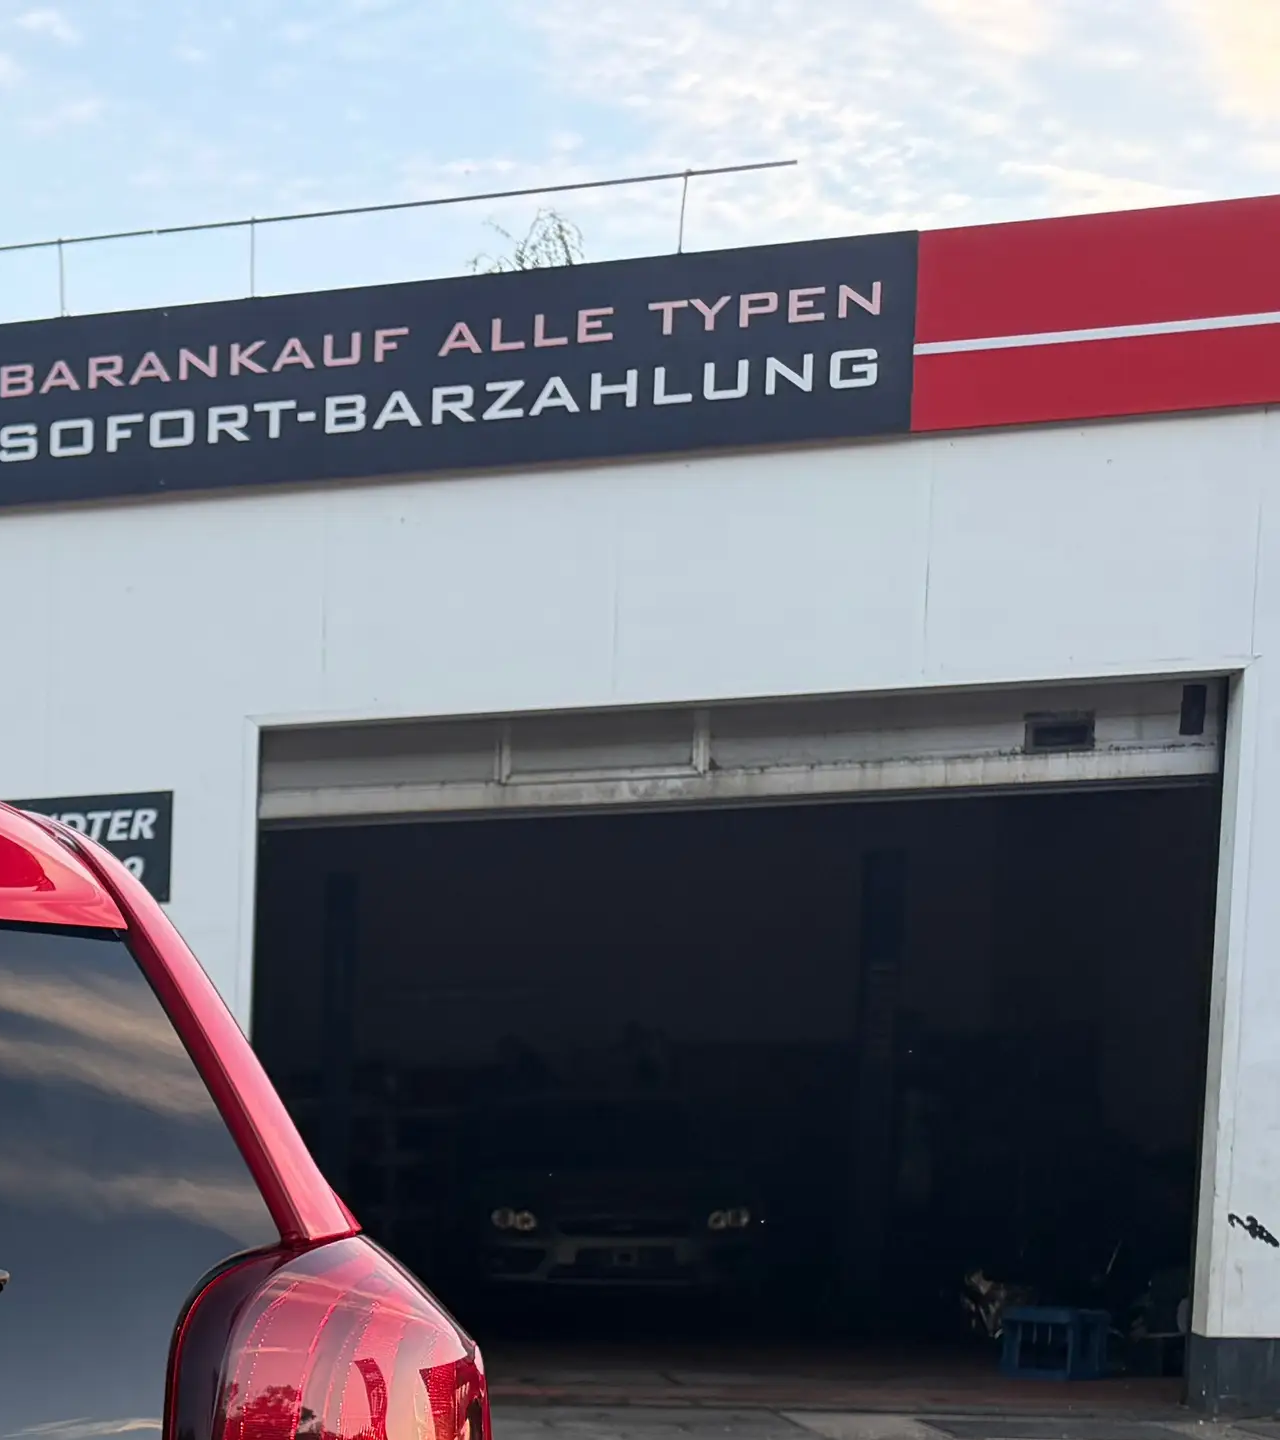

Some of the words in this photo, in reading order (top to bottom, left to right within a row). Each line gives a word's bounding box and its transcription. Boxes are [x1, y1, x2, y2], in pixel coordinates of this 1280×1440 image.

[0, 327, 410, 399] BARANKAUF
[437, 306, 615, 358] ALLE
[647, 280, 883, 336] TYPEN
